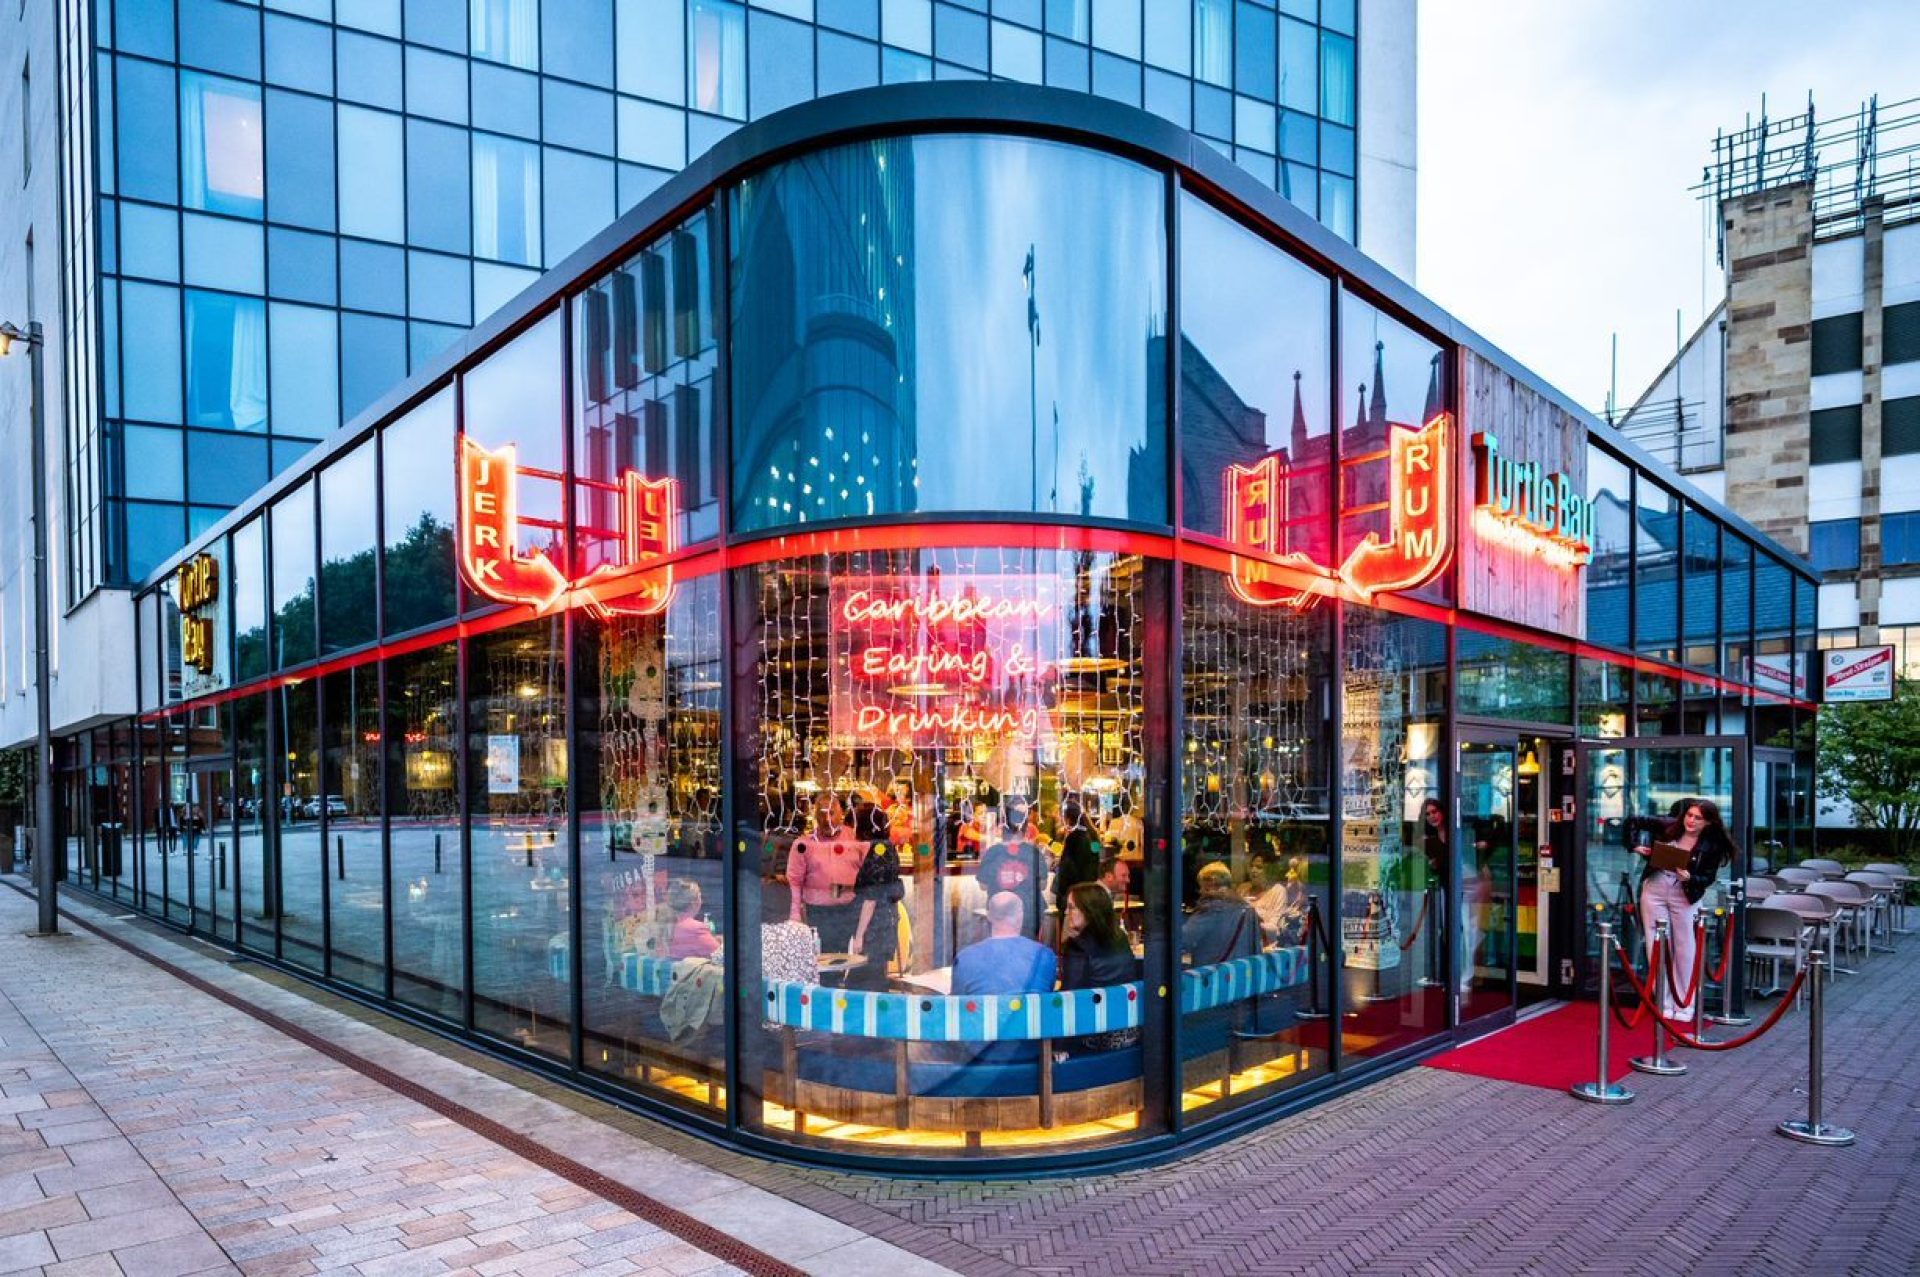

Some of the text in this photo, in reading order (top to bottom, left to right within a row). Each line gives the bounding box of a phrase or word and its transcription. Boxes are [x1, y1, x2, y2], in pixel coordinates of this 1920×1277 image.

[474, 459, 501, 581] JERK
[1404, 444, 1434, 561] RUM
[1472, 431, 1596, 566] Turtle Bay
[843, 590, 1053, 622] Caribbean
[183, 615, 208, 672] Bay
[863, 643, 1036, 682] Eating &
[857, 703, 1038, 739] Drinking
